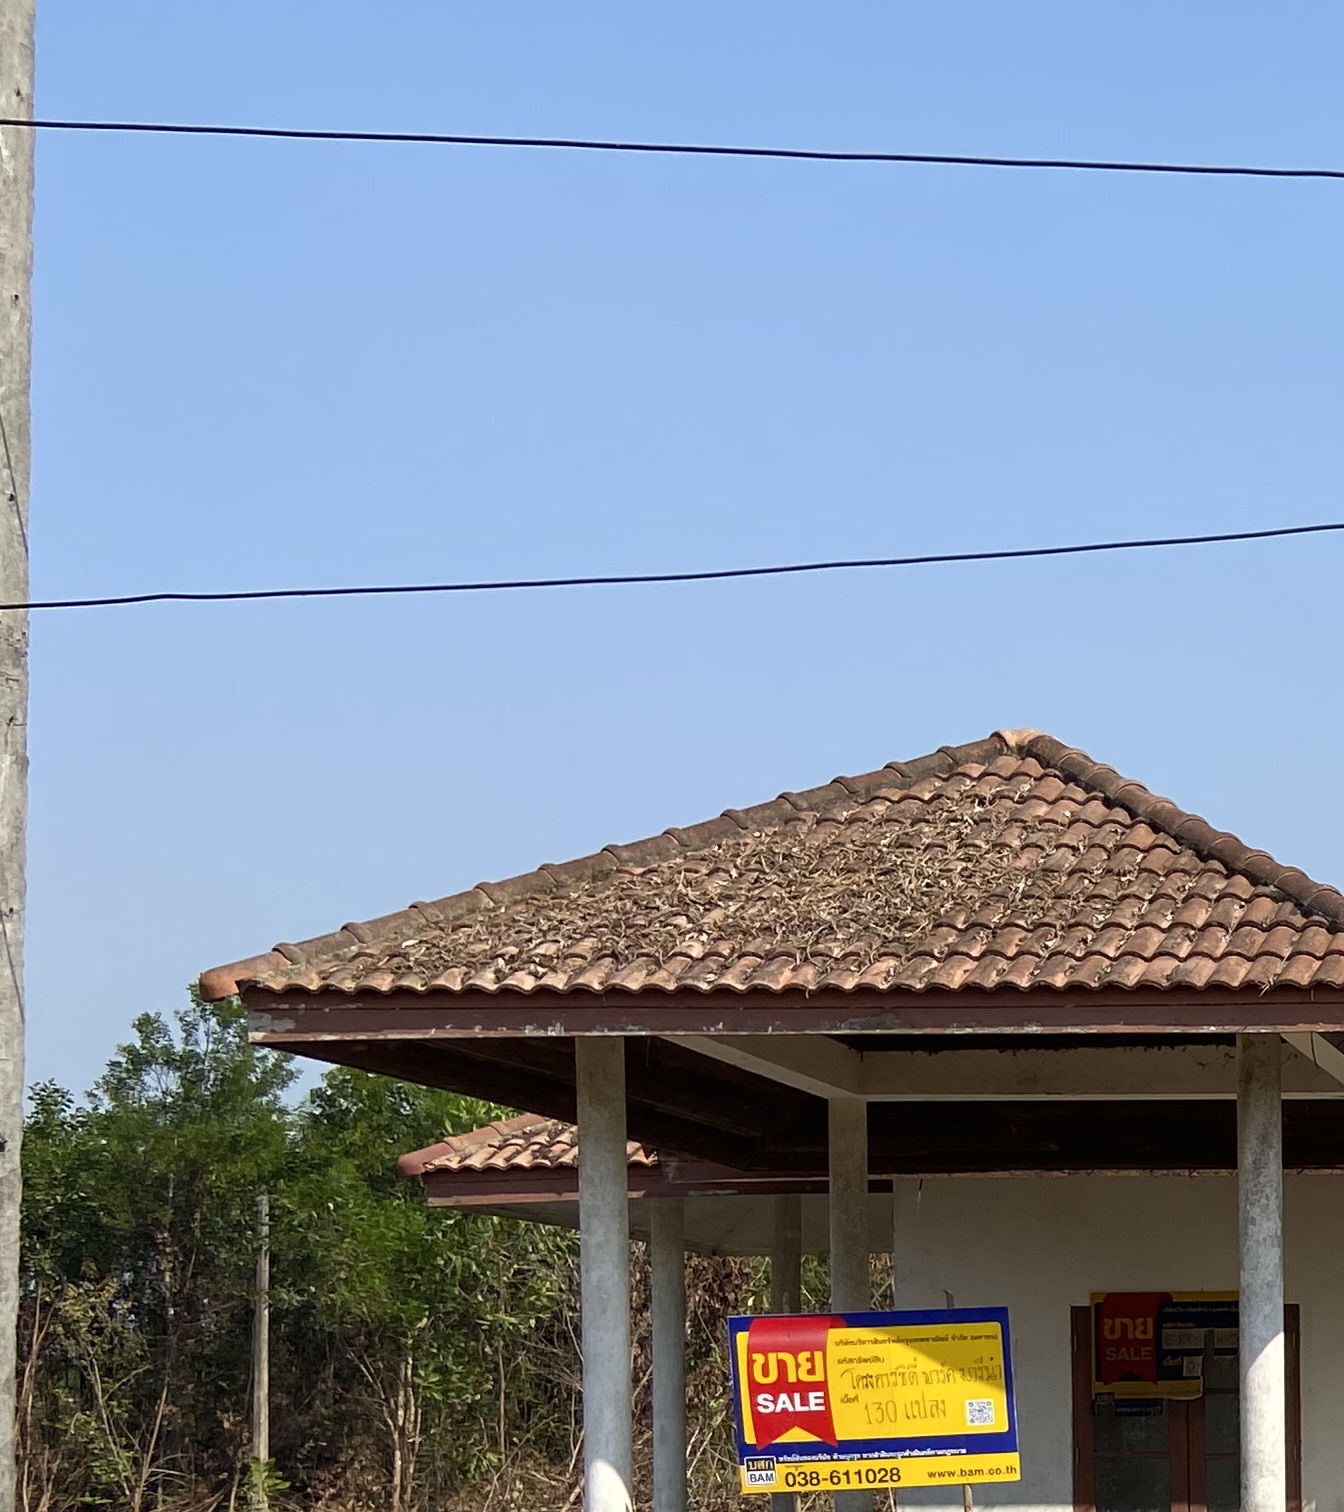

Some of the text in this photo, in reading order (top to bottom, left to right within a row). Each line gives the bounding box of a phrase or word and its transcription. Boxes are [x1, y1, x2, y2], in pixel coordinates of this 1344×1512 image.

[1104, 1317, 1153, 1340] ขาย
[1105, 1346, 1153, 1361] SALE
[751, 1350, 826, 1385] ขาย
[756, 1391, 826, 1414] SALE
[864, 1400, 897, 1425] 130
[749, 1472, 775, 1483] BAM
[784, 1467, 902, 1488] 038-611028
[927, 1464, 1018, 1479] www.bam.co.th
